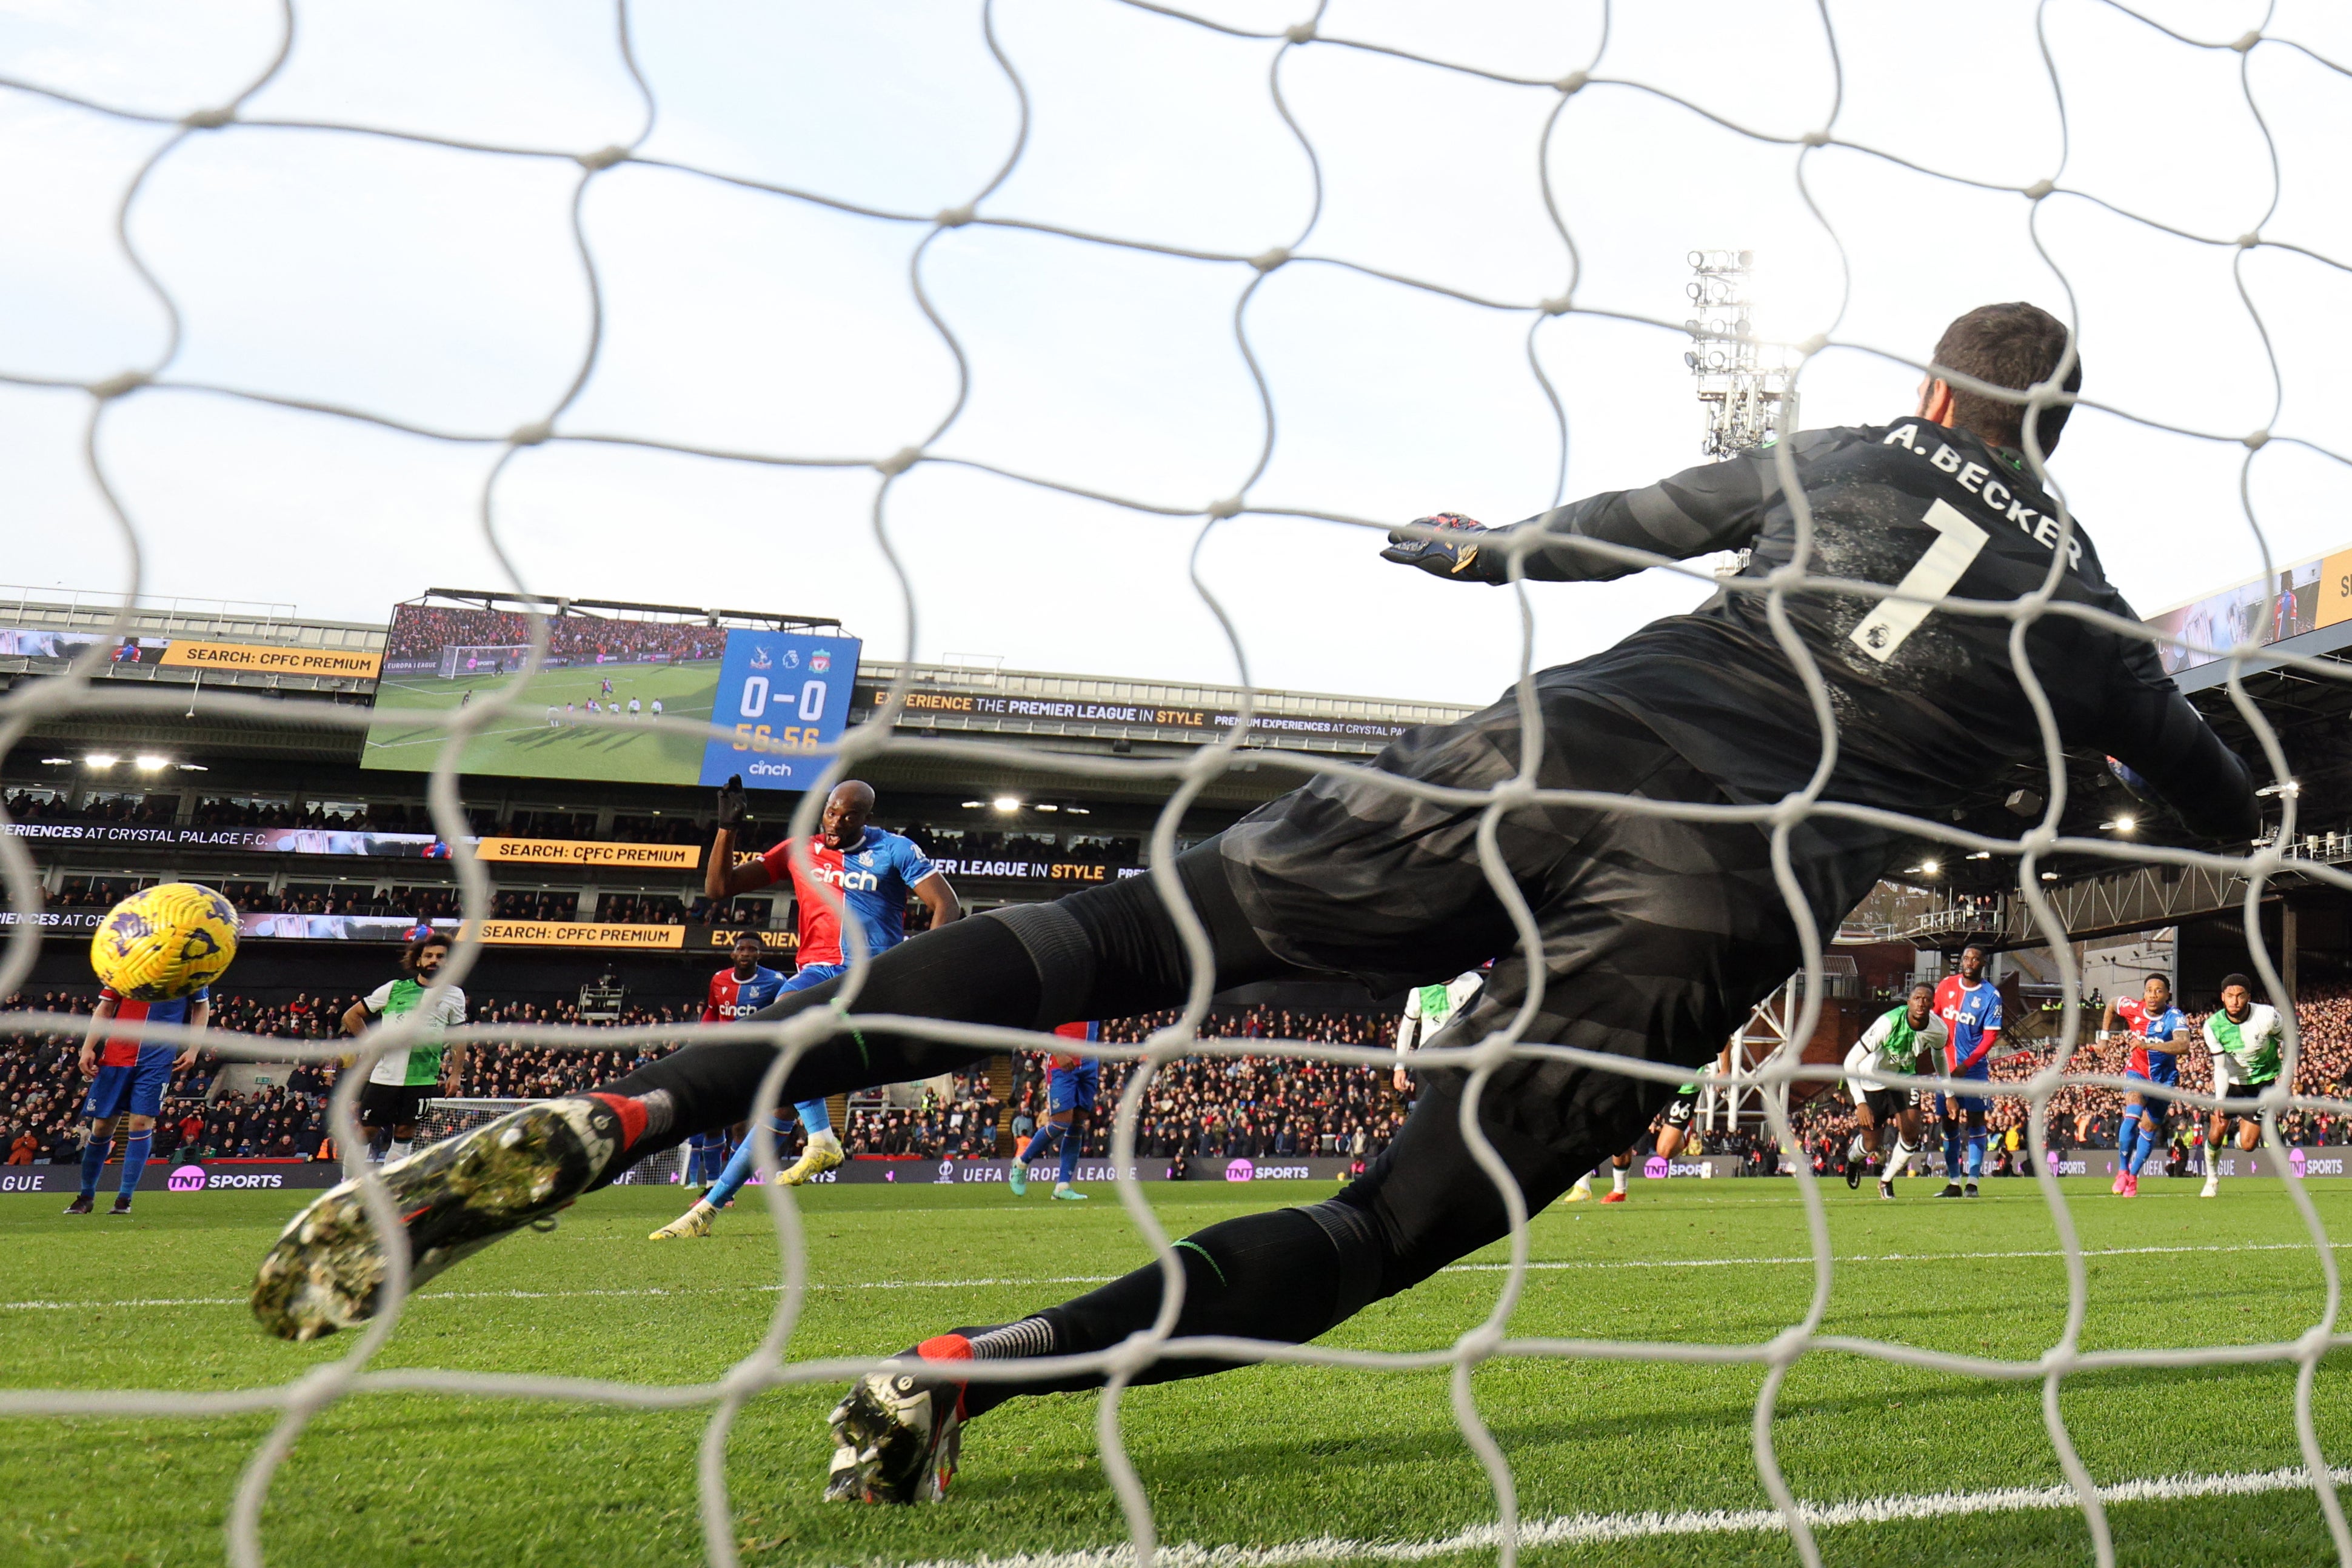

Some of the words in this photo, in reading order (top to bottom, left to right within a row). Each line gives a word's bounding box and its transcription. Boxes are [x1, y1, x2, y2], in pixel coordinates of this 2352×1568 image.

[1883, 423, 1927, 456] A.
[1929, 442, 2083, 572] BECKER
[1848, 497, 1991, 663] 1
[187, 648, 256, 664] SEARCH:
[259, 653, 300, 667] CPFC
[302, 656, 372, 671] PREMIUM
[874, 691, 974, 712] EXERIENCE
[976, 698, 1007, 713] THE
[1008, 700, 1075, 719] PREMIER
[1077, 705, 1137, 722] LEAGUE
[1138, 709, 1155, 722] IN
[1156, 710, 1204, 727] STYLE
[1214, 715, 1261, 728] PREMUM
[1261, 718, 1331, 732] EXPERIENCES
[1332, 722, 1343, 733] AT
[1346, 723, 1388, 736] CRYSTAL
[732, 723, 820, 756] 56:56
[749, 760, 792, 776] cinch
[85, 827, 107, 839] AT
[107, 827, 176, 843] CRYSTAL
[178, 831, 239, 846] PALACE
[242, 833, 269, 846] F.C.
[499, 843, 569, 858] SEARCH:
[573, 846, 614, 860] CPFC
[616, 849, 686, 863] PREMIUM
[810, 862, 878, 892] cinch
[960, 860, 1029, 877] LEAGUE
[1031, 862, 1049, 878] IN
[1051, 864, 1106, 881] STYLE
[61, 914, 84, 927] AT
[482, 925, 552, 940] SEARCH:
[556, 928, 597, 941] CPFC
[600, 930, 670, 943] PREMIUM
[719, 1000, 758, 1016] cinch
[1942, 1004, 1977, 1026] cinch
[1669, 1099, 1691, 1120] 66
[963, 1167, 1003, 1182] UEFA
[1226, 1168, 1253, 1178] TNT
[1254, 1166, 1309, 1179] SPORTS
[2059, 1161, 2086, 1175] SPORTS
[2143, 1160, 2163, 1176] UEFA
[2307, 1159, 2343, 1175] SPORTS
[169, 1175, 207, 1189] TNT
[208, 1174, 283, 1189] SPORTS
